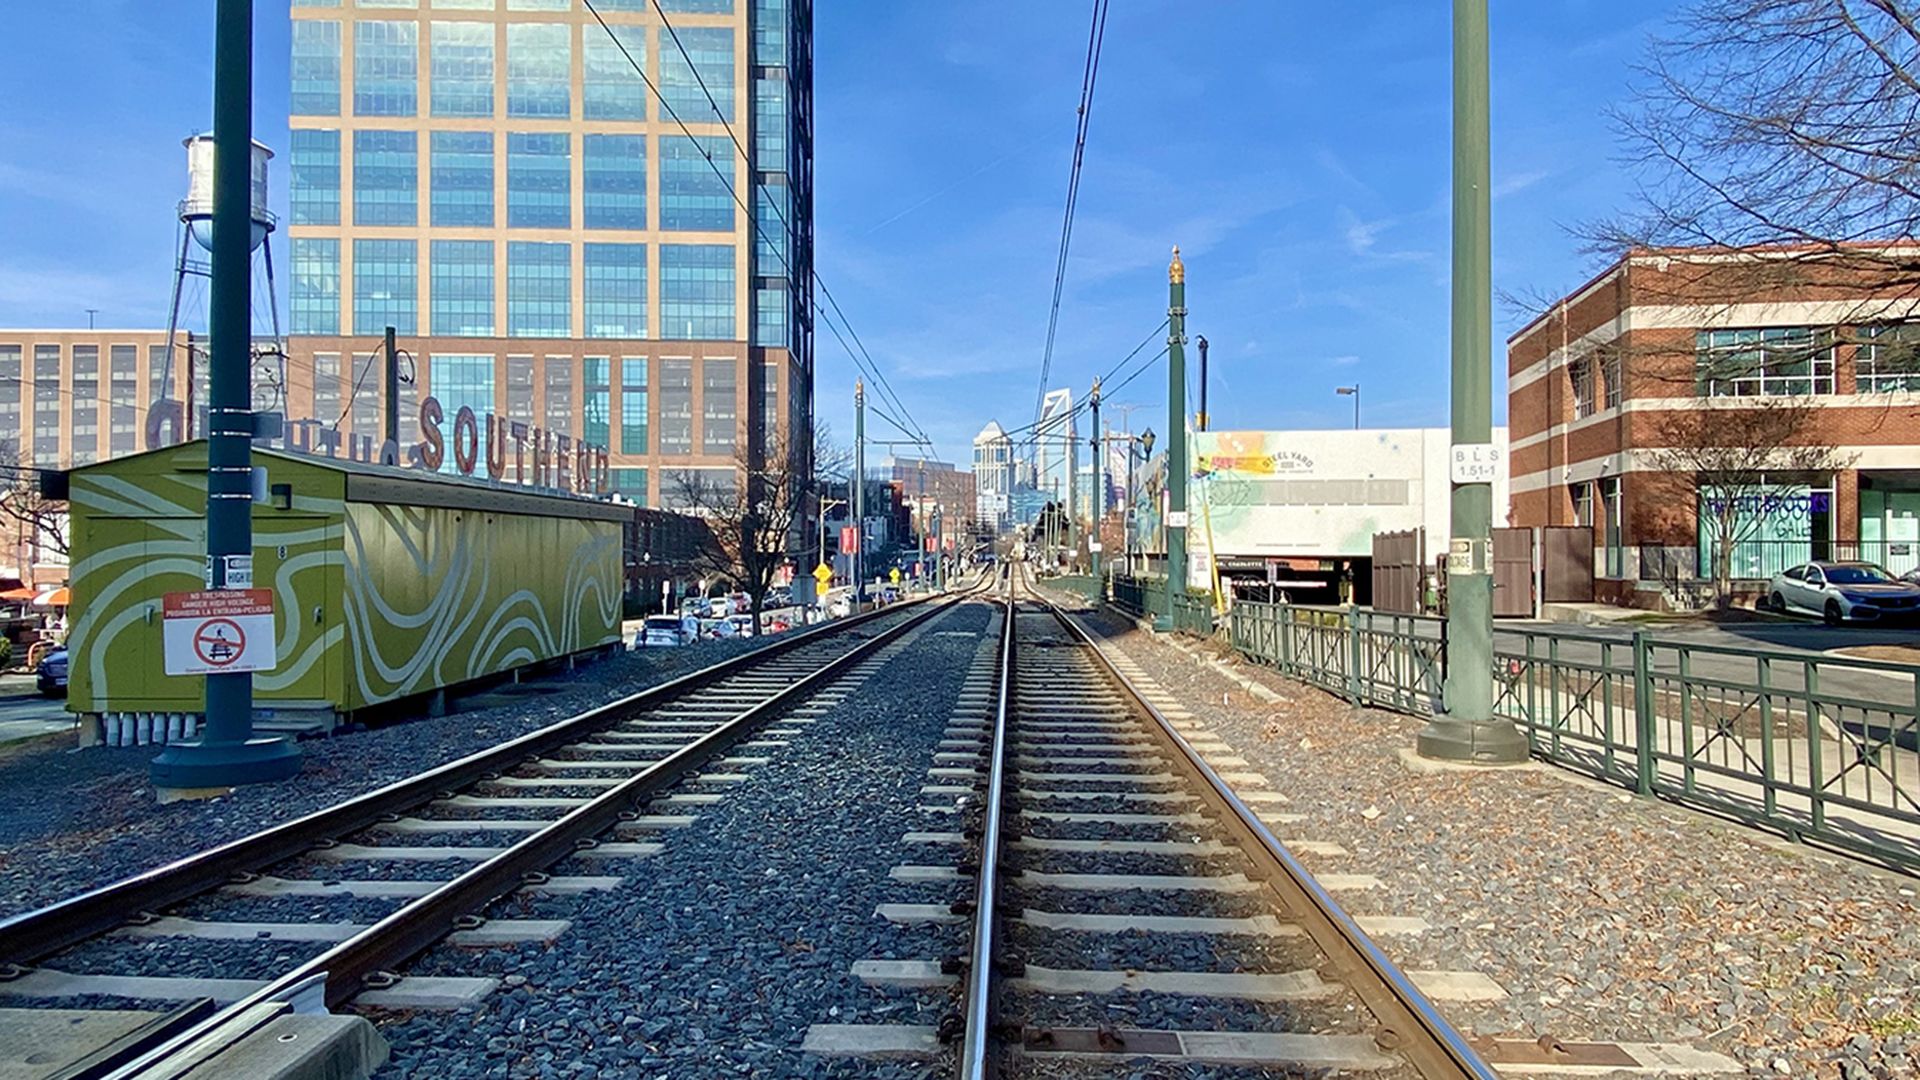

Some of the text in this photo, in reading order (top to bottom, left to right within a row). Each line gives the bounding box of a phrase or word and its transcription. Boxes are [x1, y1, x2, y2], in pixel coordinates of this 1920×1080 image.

[420, 396, 609, 493] SOUTHEND
[1262, 451, 1288, 468] STEEL
[1291, 451, 1314, 468] YARD
[1460, 465, 1495, 476] 1.51-1
[190, 591, 246, 600] NO TRESPASSING
[181, 601, 208, 609] DANGER
[228, 598, 255, 606] VOLTAGE
[202, 608, 212, 616] LA
